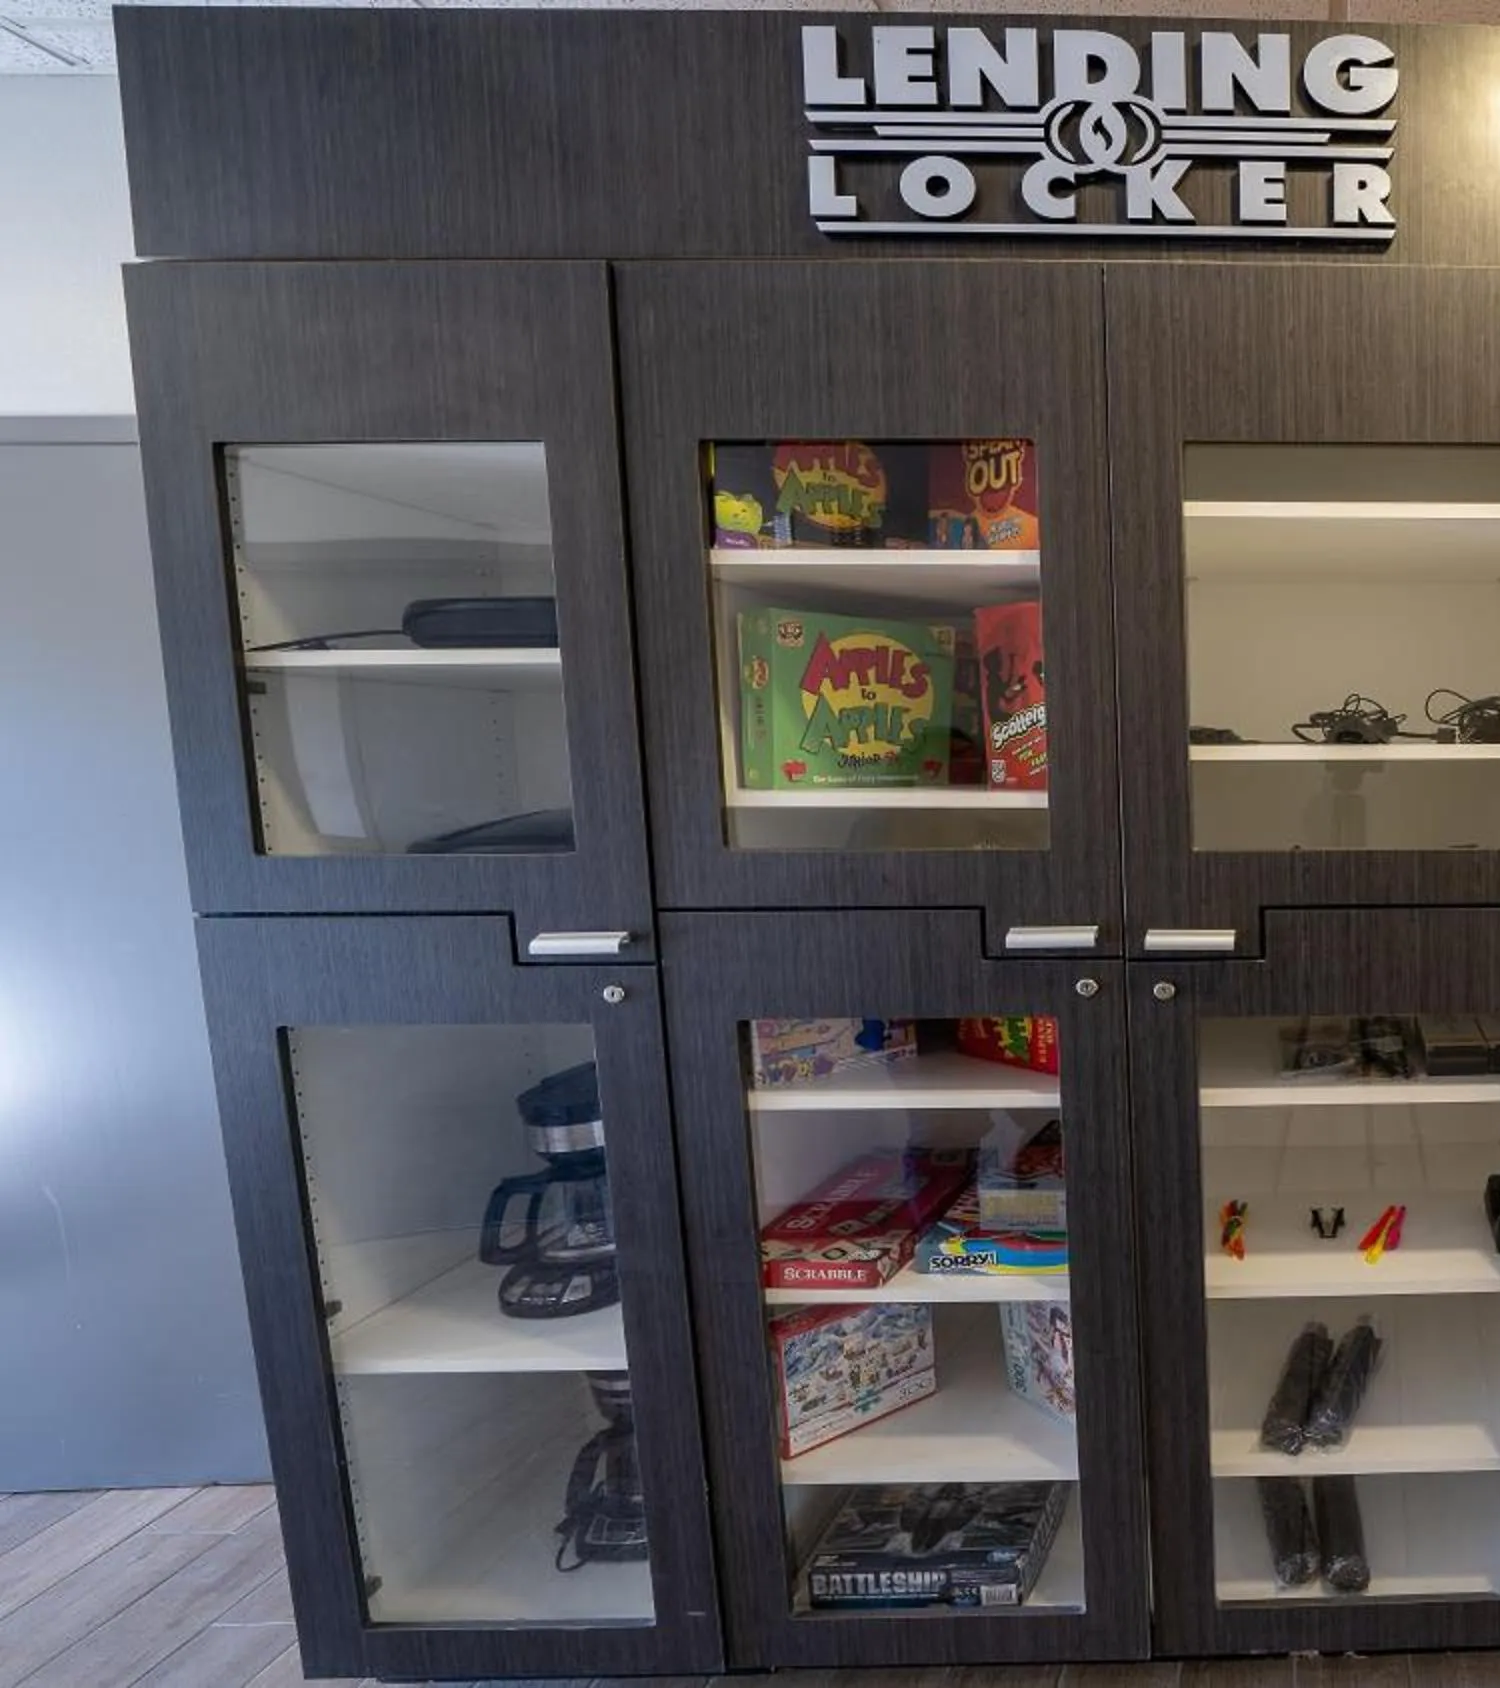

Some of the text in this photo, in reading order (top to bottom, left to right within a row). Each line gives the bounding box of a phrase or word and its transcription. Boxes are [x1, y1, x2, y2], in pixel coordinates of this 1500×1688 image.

[802, 25, 1399, 115] LENDING
[808, 155, 1396, 223] LOCKER
[969, 452, 1020, 495] OUT
[800, 631, 931, 698] APPLES
[861, 687, 876, 701] to
[800, 692, 926, 754] APPLES
[783, 1266, 867, 1281] SCRABBLE
[811, 1571, 946, 1596] BATTLESHIP
